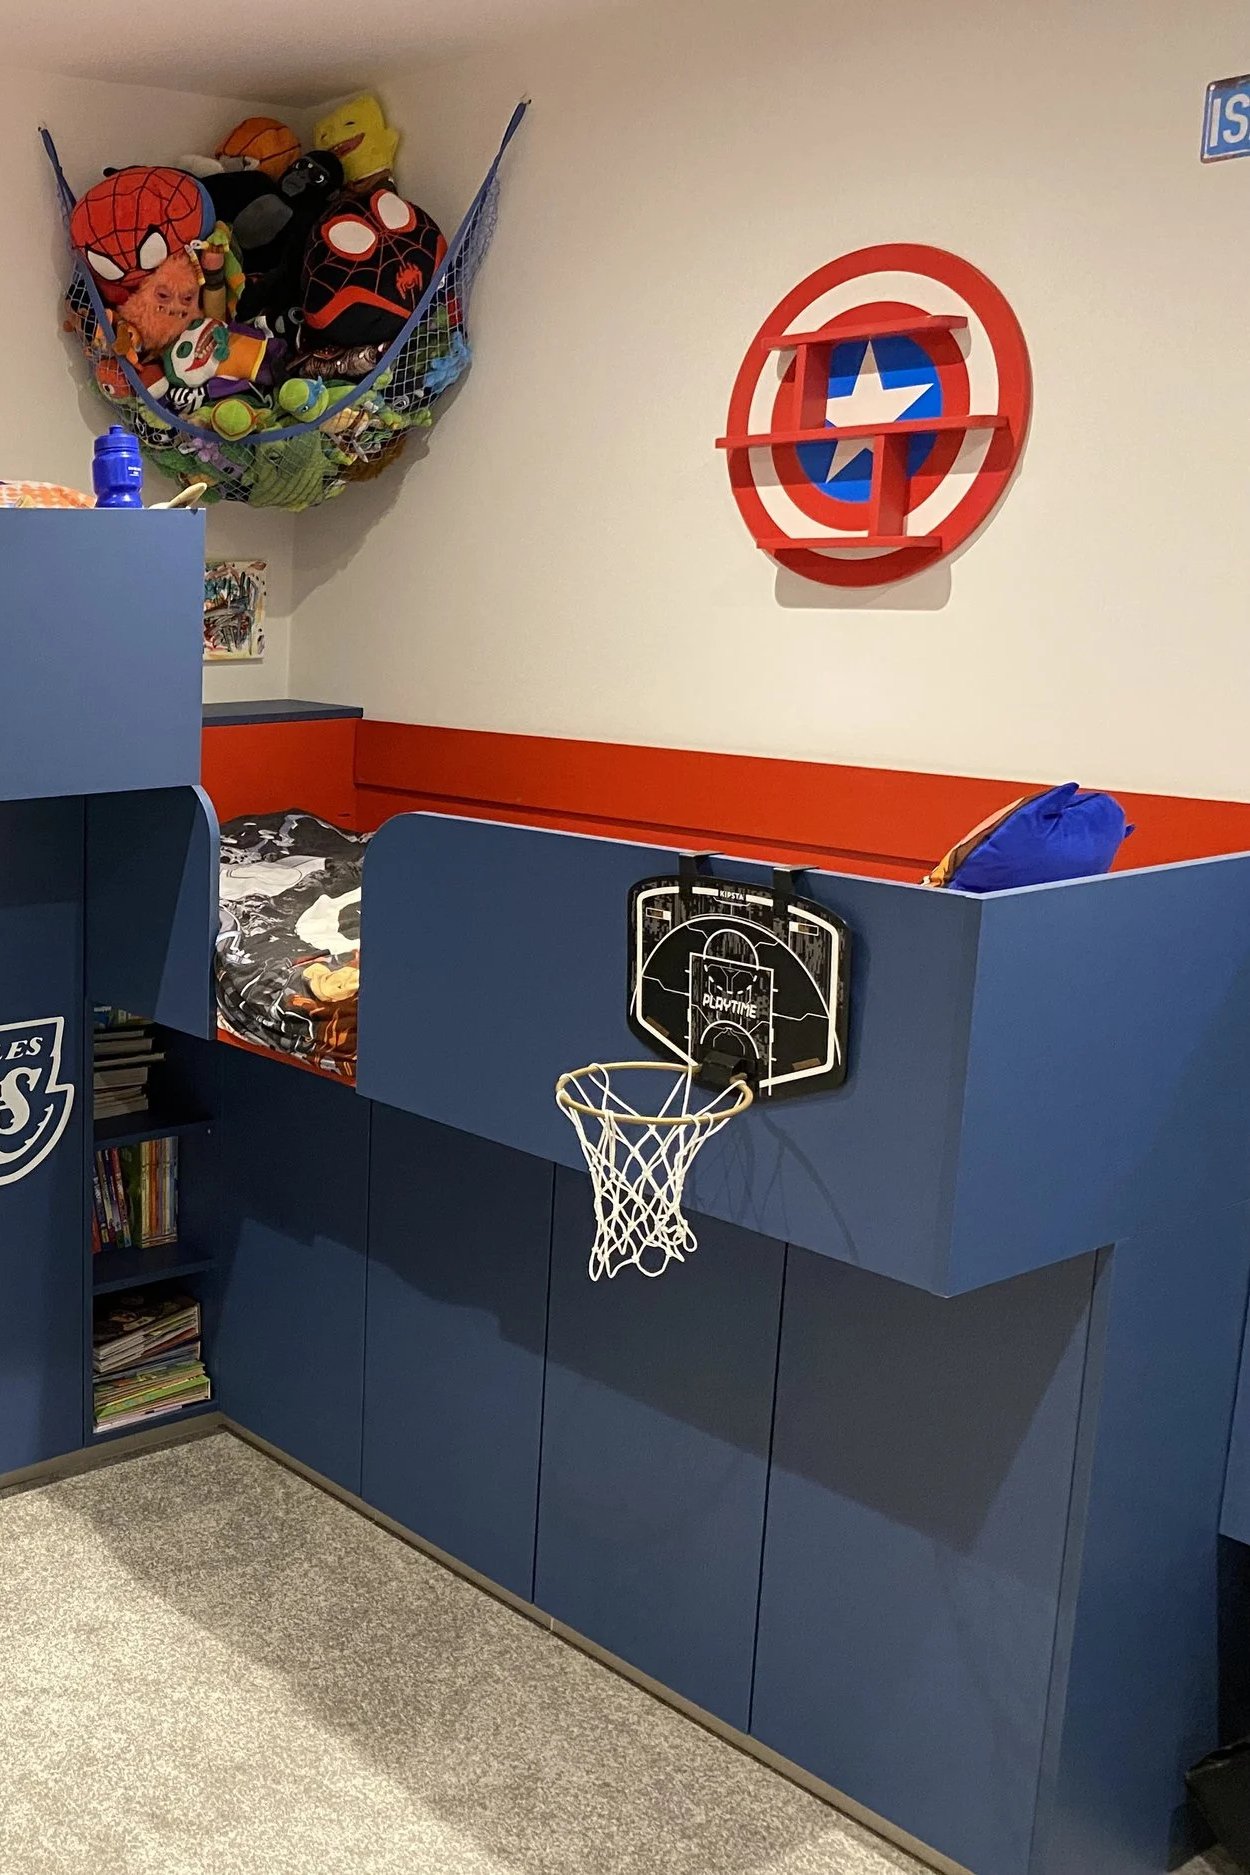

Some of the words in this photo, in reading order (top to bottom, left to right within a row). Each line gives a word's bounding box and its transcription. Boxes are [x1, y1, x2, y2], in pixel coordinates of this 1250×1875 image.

[1210, 93, 1250, 147] IS
[719, 890, 745, 901] KIPSTA
[702, 993, 758, 1019] PLAYTIME
